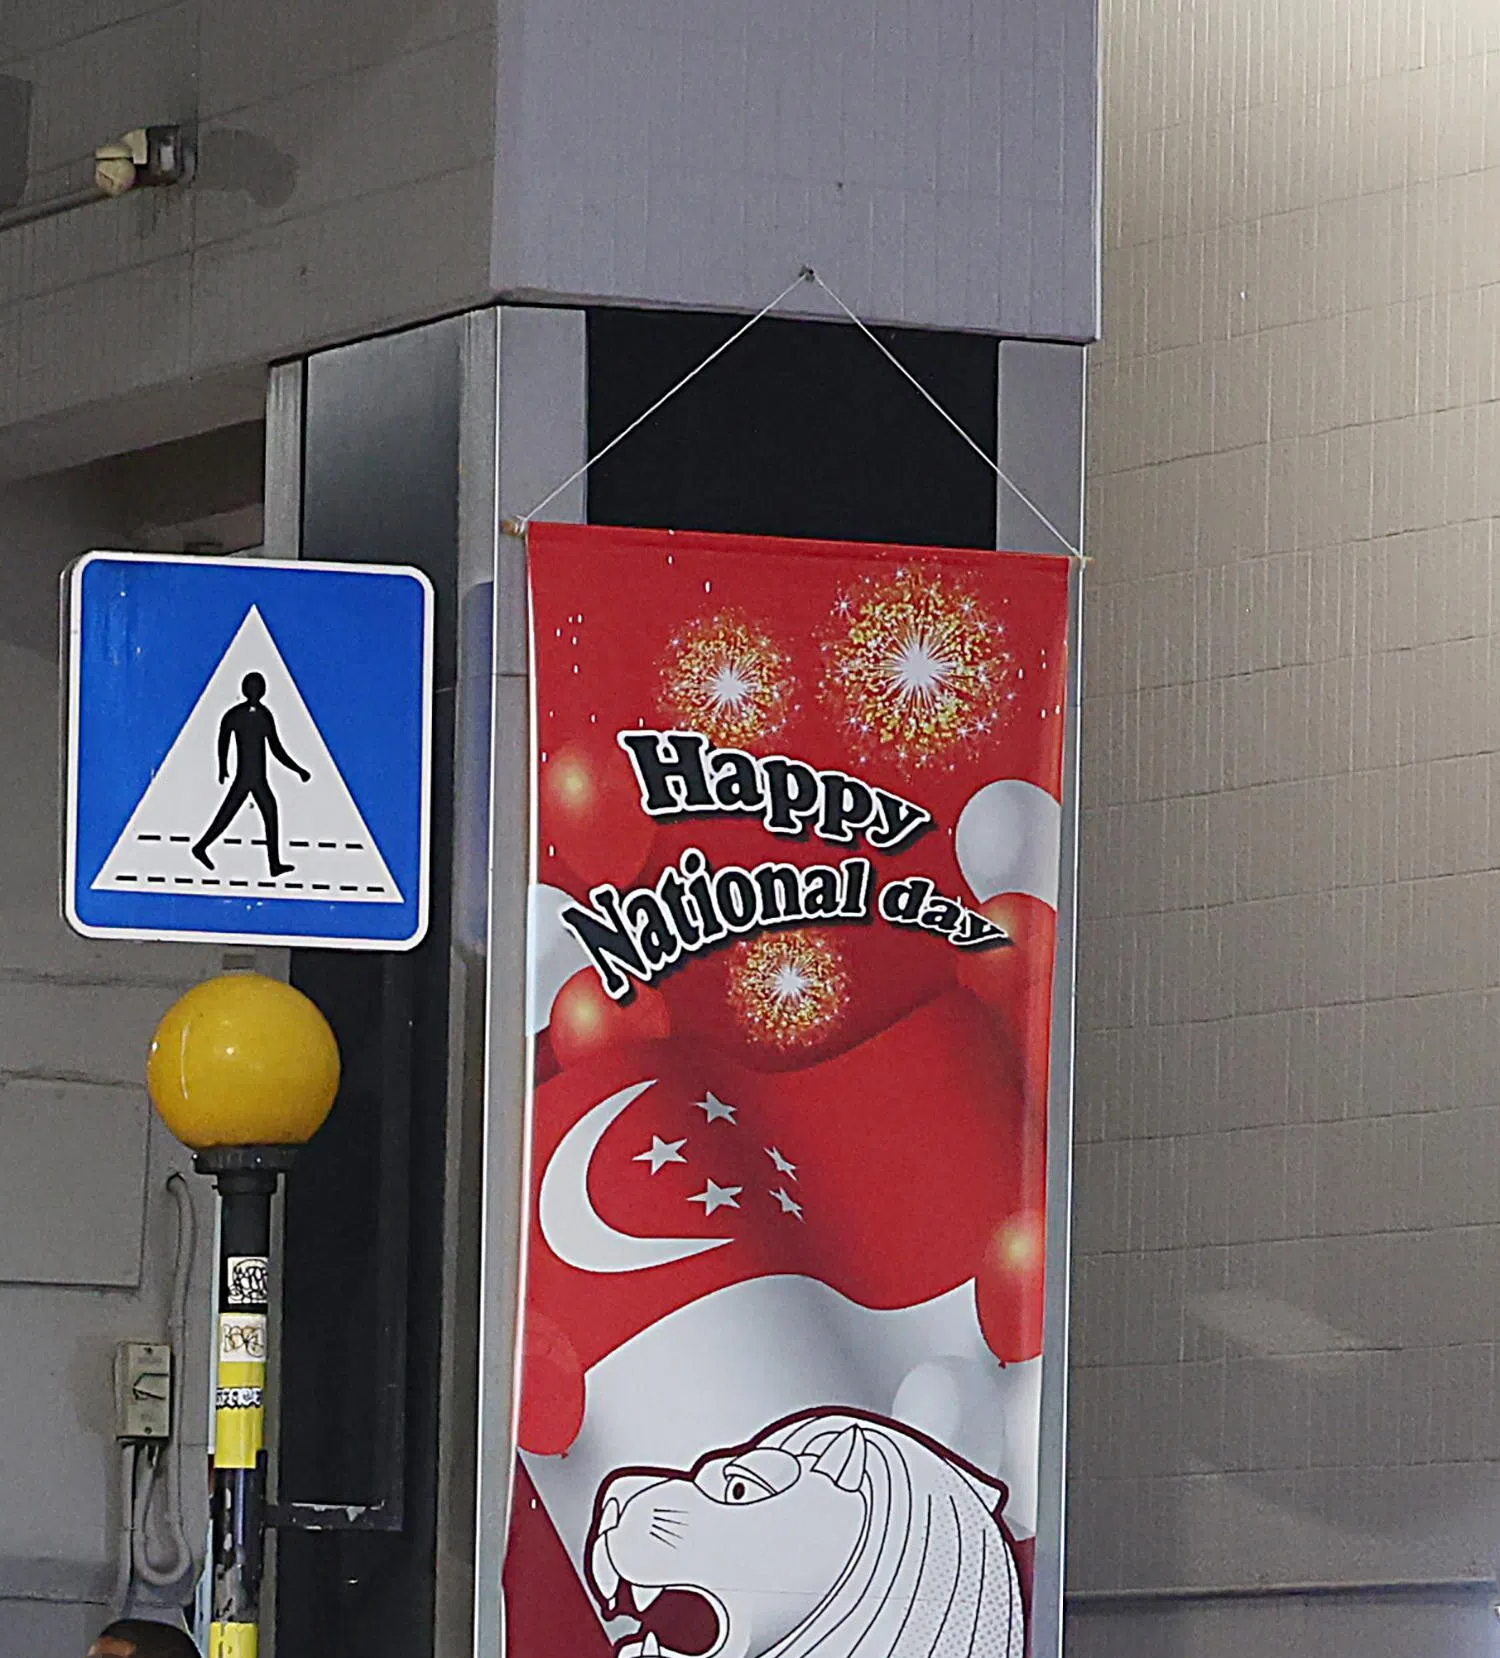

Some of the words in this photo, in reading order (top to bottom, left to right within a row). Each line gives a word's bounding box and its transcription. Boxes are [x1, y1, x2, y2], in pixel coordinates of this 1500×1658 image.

[618, 730, 931, 848] Happy
[559, 848, 872, 1001] National
[878, 877, 1011, 948] day
